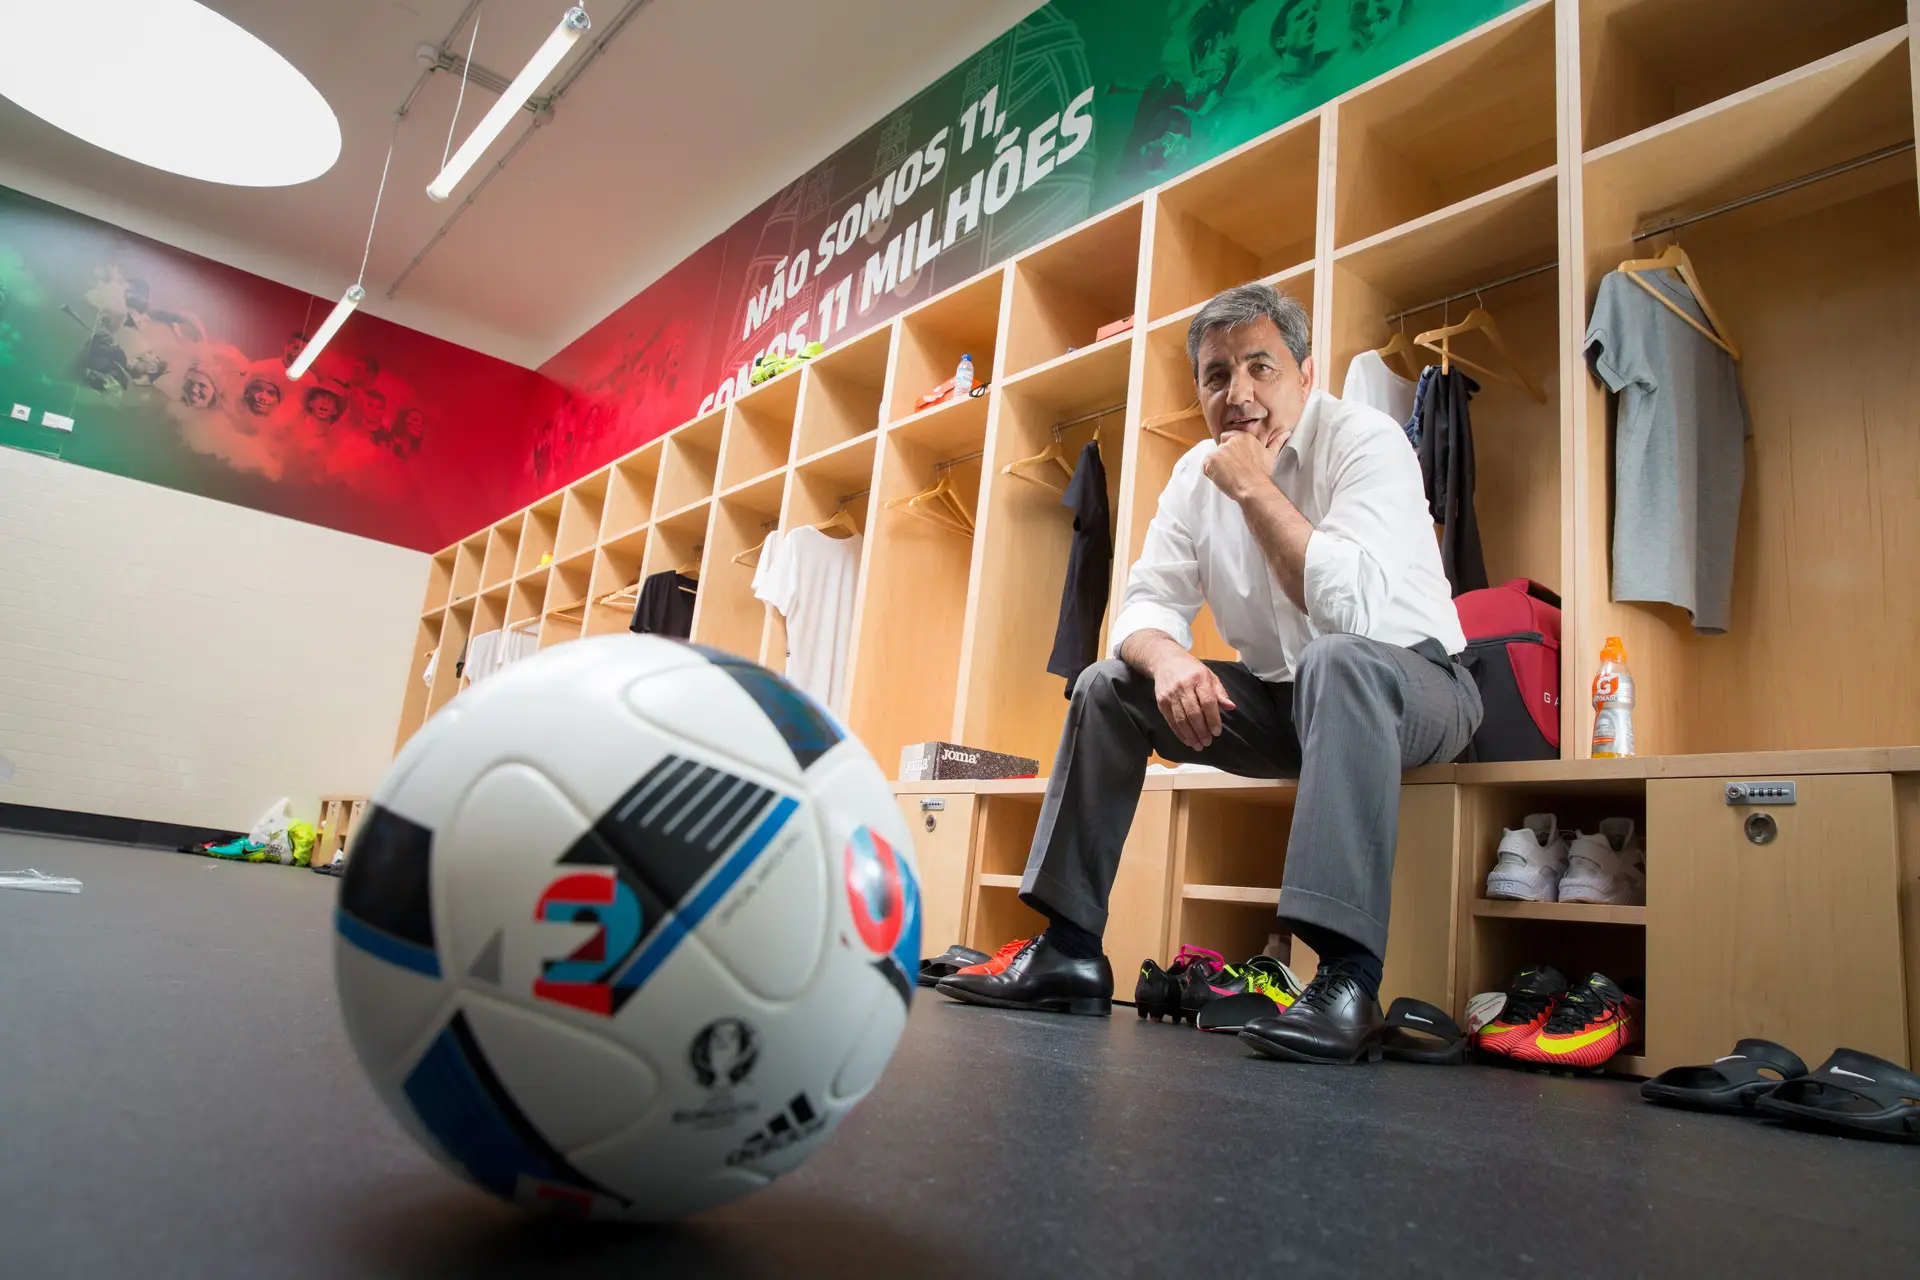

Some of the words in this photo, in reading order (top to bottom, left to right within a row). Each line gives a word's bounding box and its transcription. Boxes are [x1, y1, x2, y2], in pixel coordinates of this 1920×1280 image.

[743, 249, 811, 341] NÃO
[814, 126, 949, 276] SOMOS
[960, 84, 1006, 154] 11,
[818, 274, 852, 343] 11
[859, 85, 1095, 313] MILHÕES
